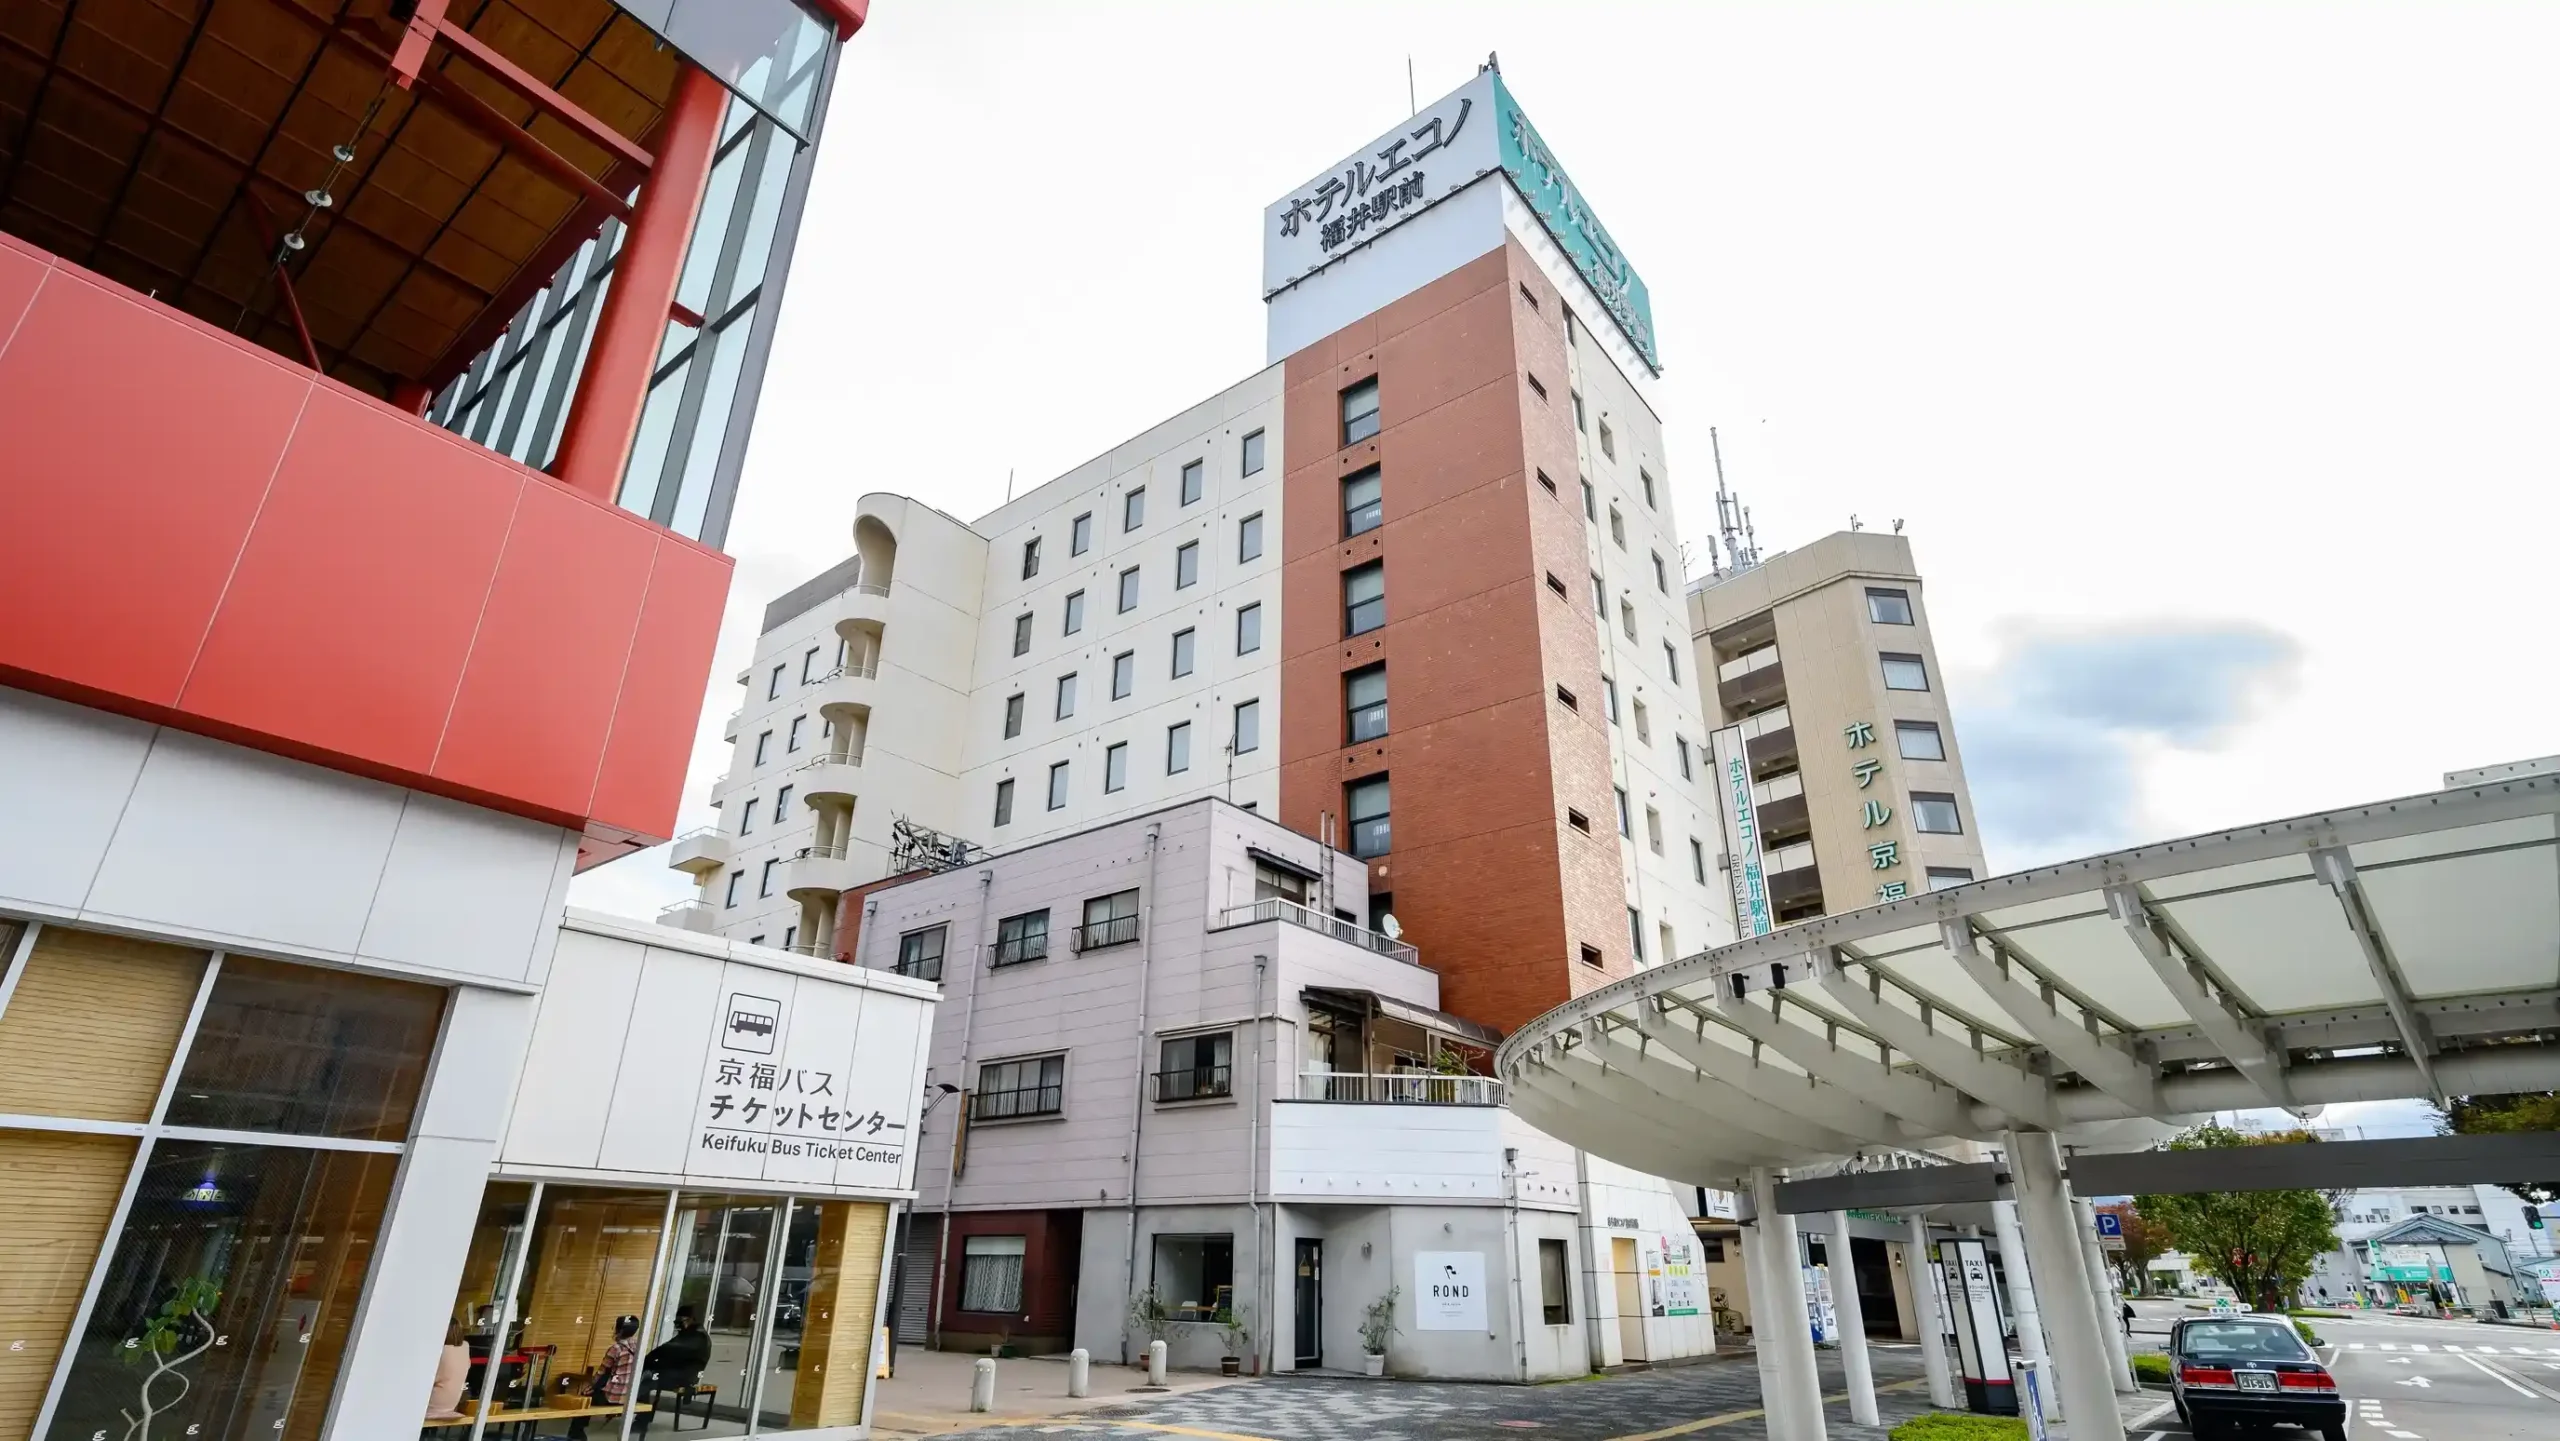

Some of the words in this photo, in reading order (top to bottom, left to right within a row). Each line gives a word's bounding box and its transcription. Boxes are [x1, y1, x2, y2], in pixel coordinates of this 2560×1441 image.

[1280, 98, 1472, 237] ホテルエコノ
[1319, 171, 1425, 253] 福井駅前
[1728, 757, 1755, 859] ホテルエコノ
[1744, 862, 1769, 937] 福井駅前
[1730, 854, 1745, 899] GREENS
[1737, 898, 1751, 939] HTELS
[715, 1057, 834, 1097] 京福バス
[709, 1093, 906, 1136] チケットセンター
[701, 1132, 767, 1155] Keifuku
[771, 1139, 801, 1157] Bus
[805, 1142, 854, 1161] Ticket
[855, 1147, 902, 1165] Center
[2101, 1216, 2116, 1233] P
[1945, 1259, 1958, 1267] TAXI
[1964, 1259, 1983, 1267] TAXI
[1433, 1284, 1470, 1298] ROND
